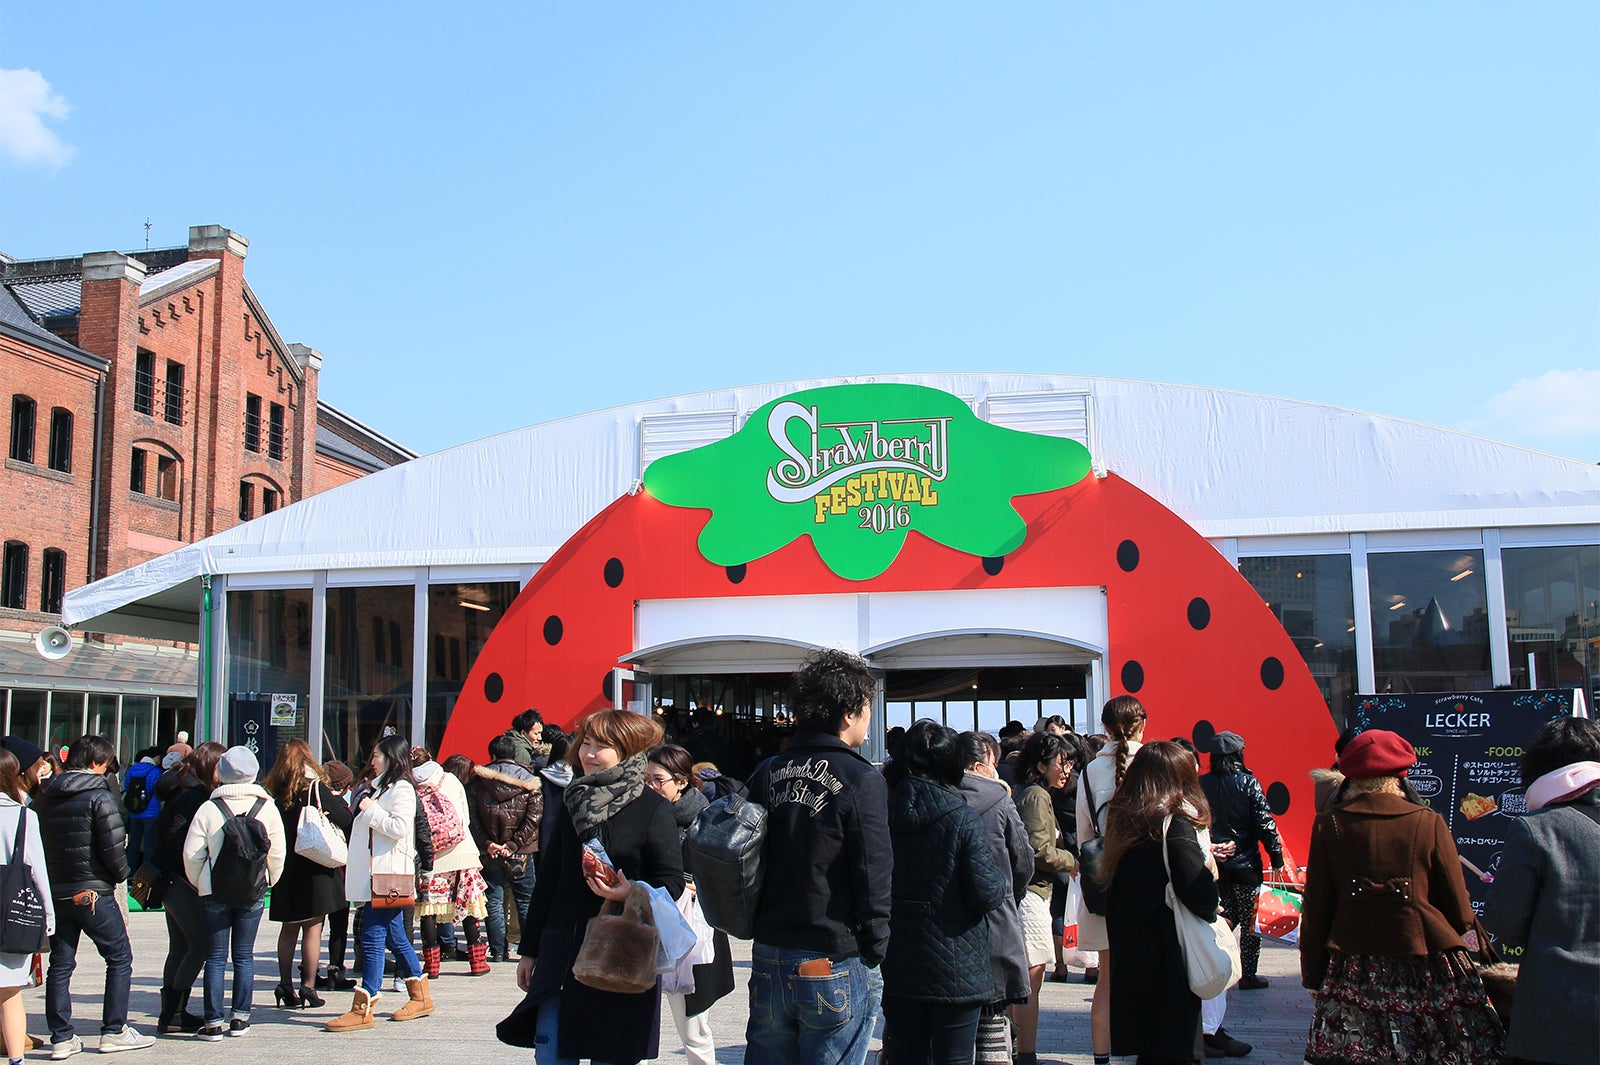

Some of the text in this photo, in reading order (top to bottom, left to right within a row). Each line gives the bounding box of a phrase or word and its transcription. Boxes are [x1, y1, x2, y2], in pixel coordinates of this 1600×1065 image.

[814, 470, 938, 524] FESTIVAL
[858, 503, 911, 534] 2016
[1425, 713, 1491, 728] LECKER
[789, 779, 830, 818] Steady
